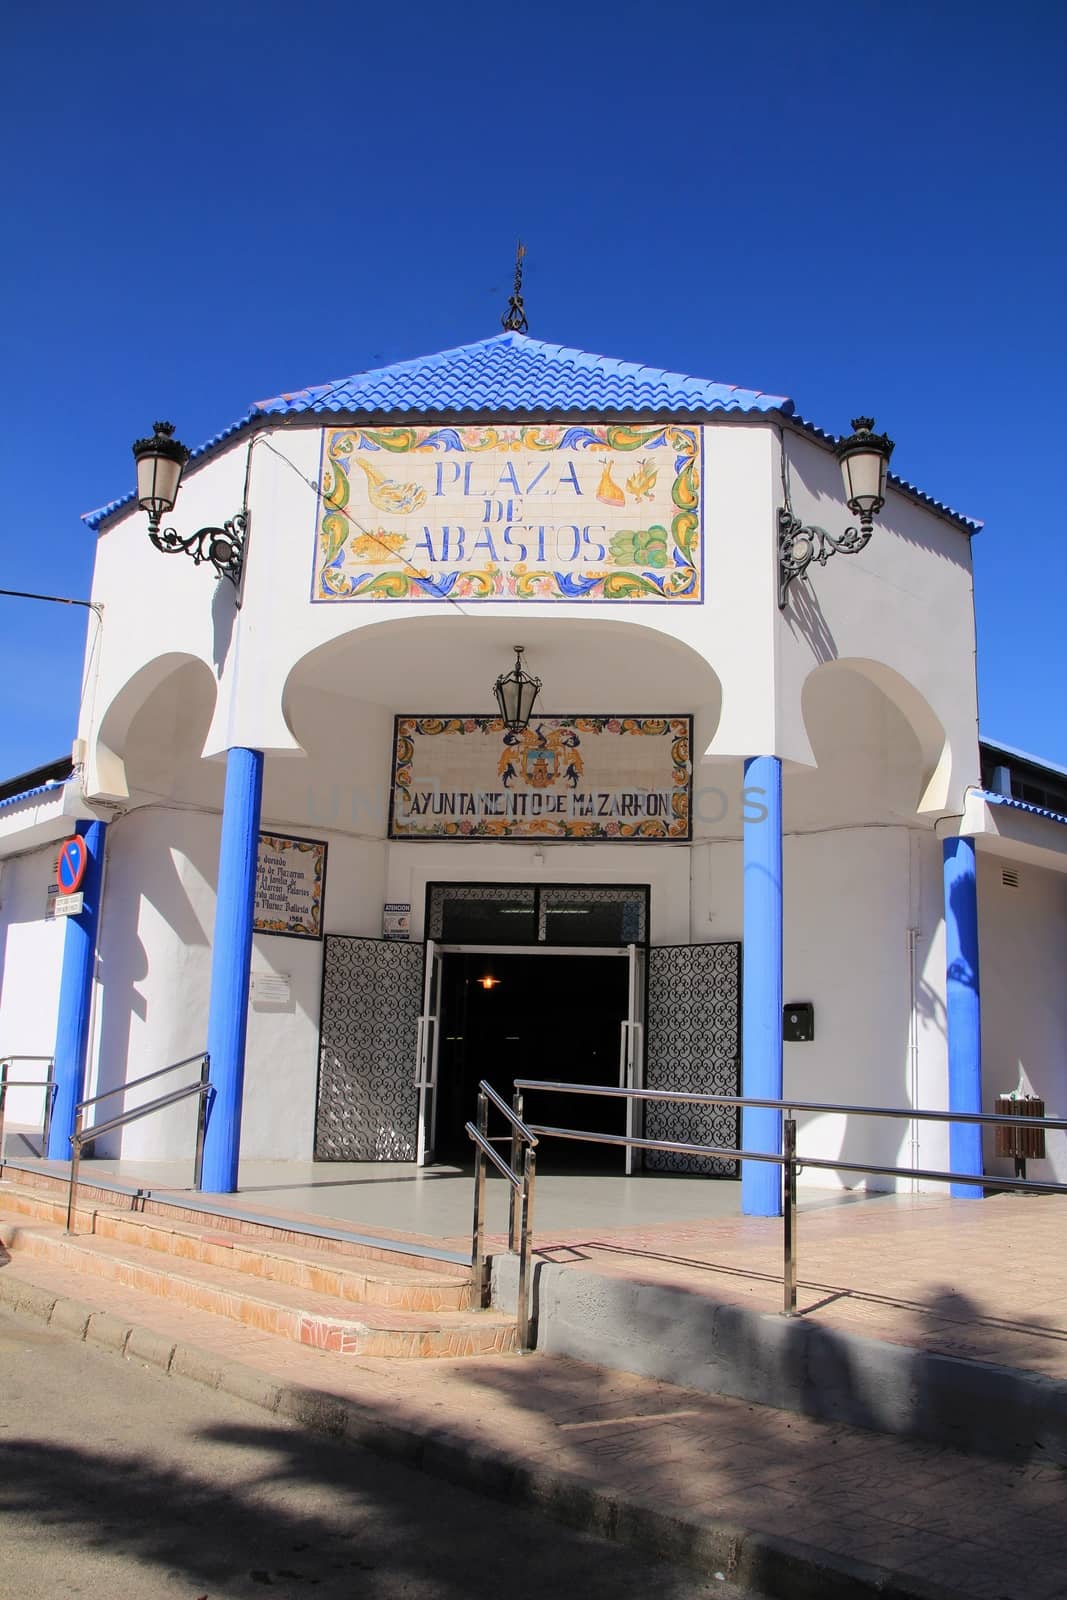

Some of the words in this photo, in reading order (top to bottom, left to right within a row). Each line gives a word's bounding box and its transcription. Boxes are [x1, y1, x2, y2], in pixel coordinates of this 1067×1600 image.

[432, 461, 584, 496] PLAZA
[482, 499, 524, 522] DE
[407, 525, 606, 562] ABASTOS
[409, 792, 542, 816] AYUNTAMIENTO
[545, 794, 568, 813] DE
